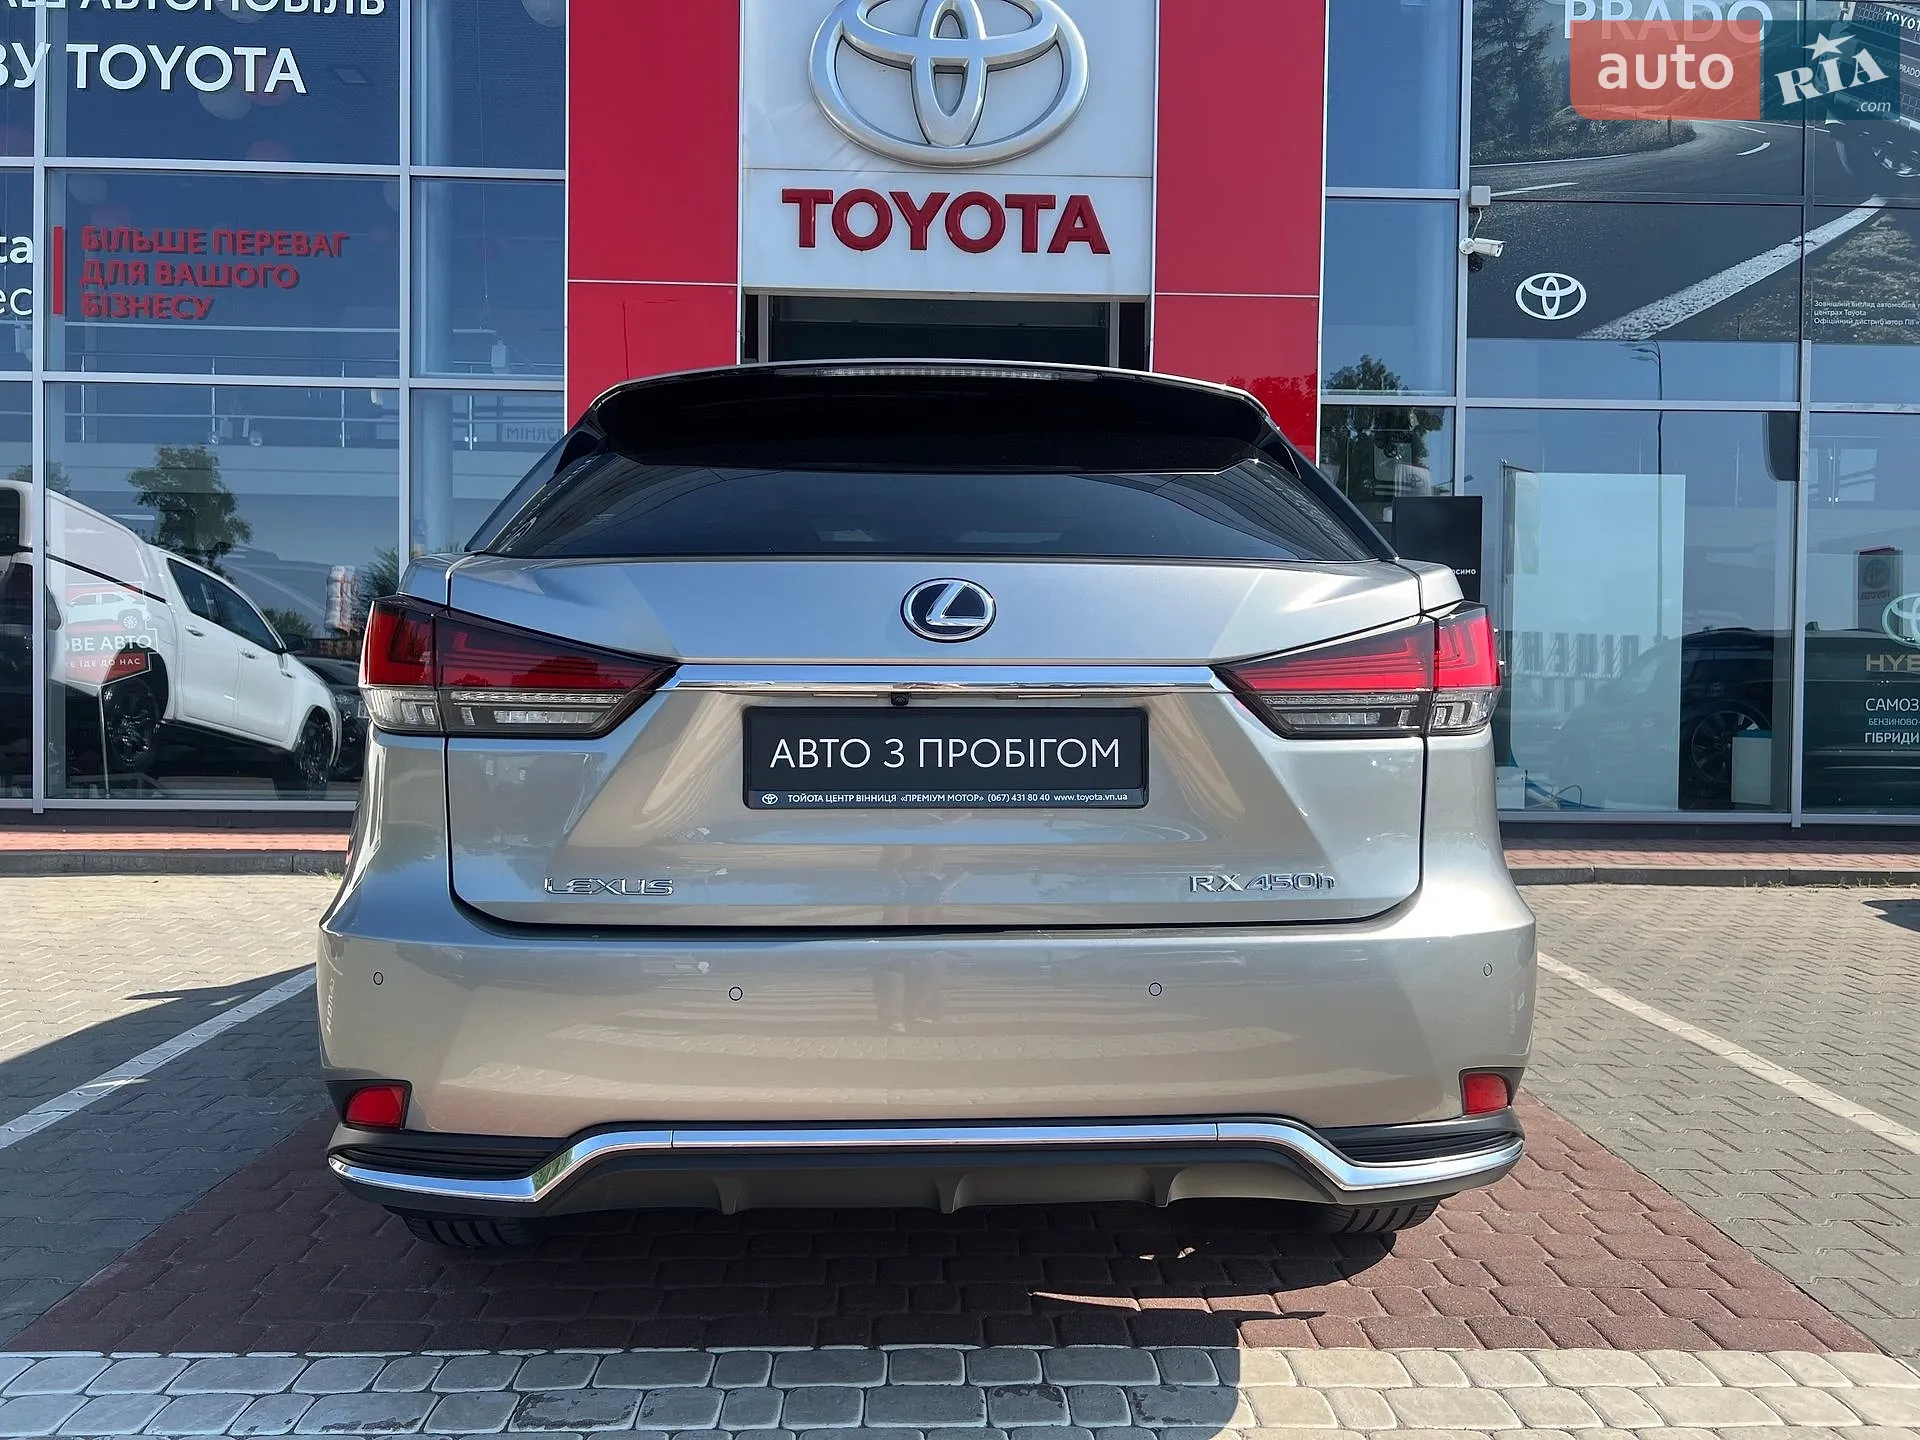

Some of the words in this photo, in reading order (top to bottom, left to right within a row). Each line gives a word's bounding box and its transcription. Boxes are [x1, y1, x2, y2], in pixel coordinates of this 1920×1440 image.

[1564, 0, 1773, 44] PRADO
[66, 44, 307, 94] TOYOTA
[781, 188, 1111, 255] TOYOTA
[81, 226, 206, 254] БІЛЬШЕ
[212, 228, 350, 257] ПЕРЕВАГ
[80, 259, 147, 289] ДЛЯ
[156, 261, 299, 289] ВАШОГО
[81, 291, 215, 320] БІЗНЕСУ
[100, 634, 151, 650] АВТО
[101, 659, 115, 668] ДО
[119, 657, 141, 666] НАС
[1865, 698, 1920, 712] САМОЗ
[769, 738, 871, 768] АВТО
[919, 738, 1119, 768] ПРОБІГОМ
[788, 793, 824, 802] ТОЙОТА
[826, 794, 854, 804] ЦЕНТР
[856, 794, 897, 804] ВІННИЦЯ
[900, 794, 944, 802] «ПРЕМІУМ
[947, 793, 984, 802] МОТОР»
[987, 793, 1010, 803] (067)
[1011, 793, 1026, 802] 431
[1027, 793, 1038, 802] 80
[1039, 793, 1050, 802] 40
[1053, 792, 1128, 803] www.toyota.vn.ua
[544, 877, 674, 896] LEXUS
